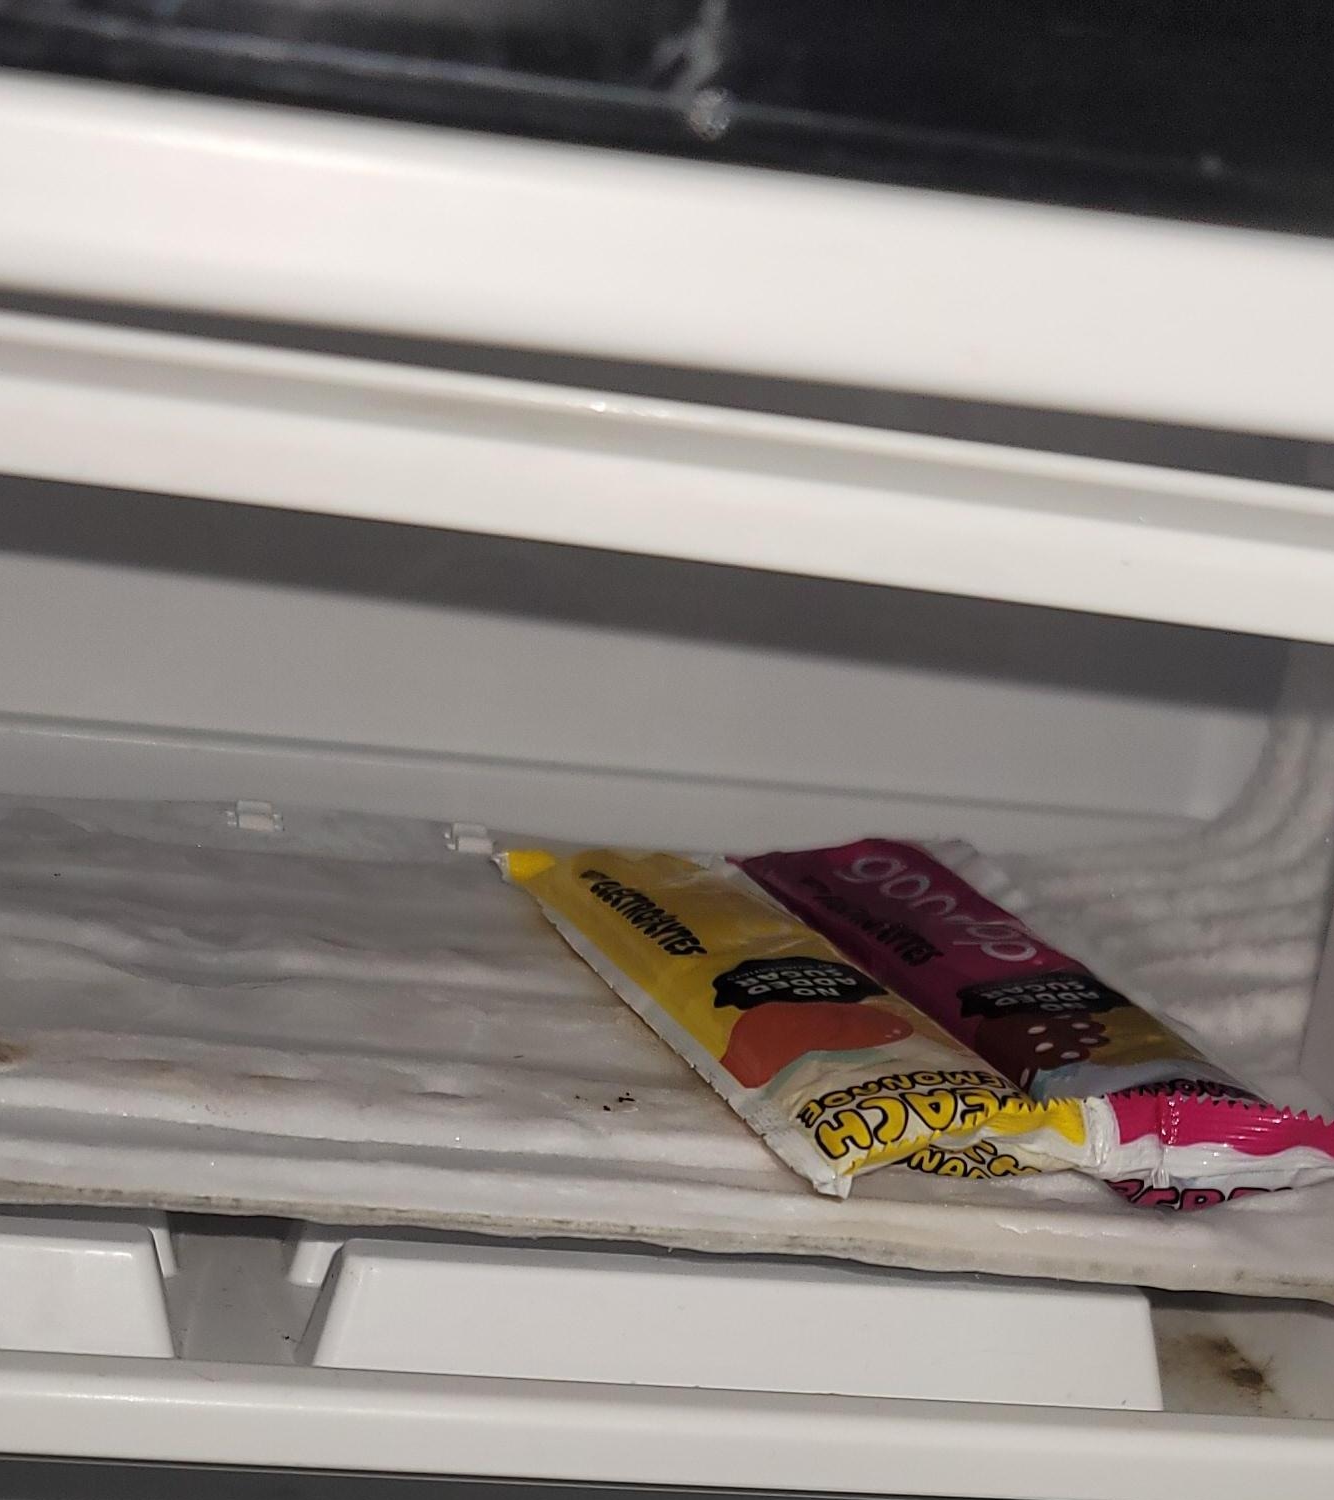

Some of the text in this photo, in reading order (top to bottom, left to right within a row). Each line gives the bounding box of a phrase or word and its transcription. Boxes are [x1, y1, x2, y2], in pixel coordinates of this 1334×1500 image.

[734, 968, 842, 987] SUGAR
[746, 976, 858, 995] ADDED
[792, 986, 840, 996] NO
[995, 990, 1099, 1007] ADDED
[796, 1070, 1011, 1128] EMONADE
[814, 1086, 1029, 1161] EACH
